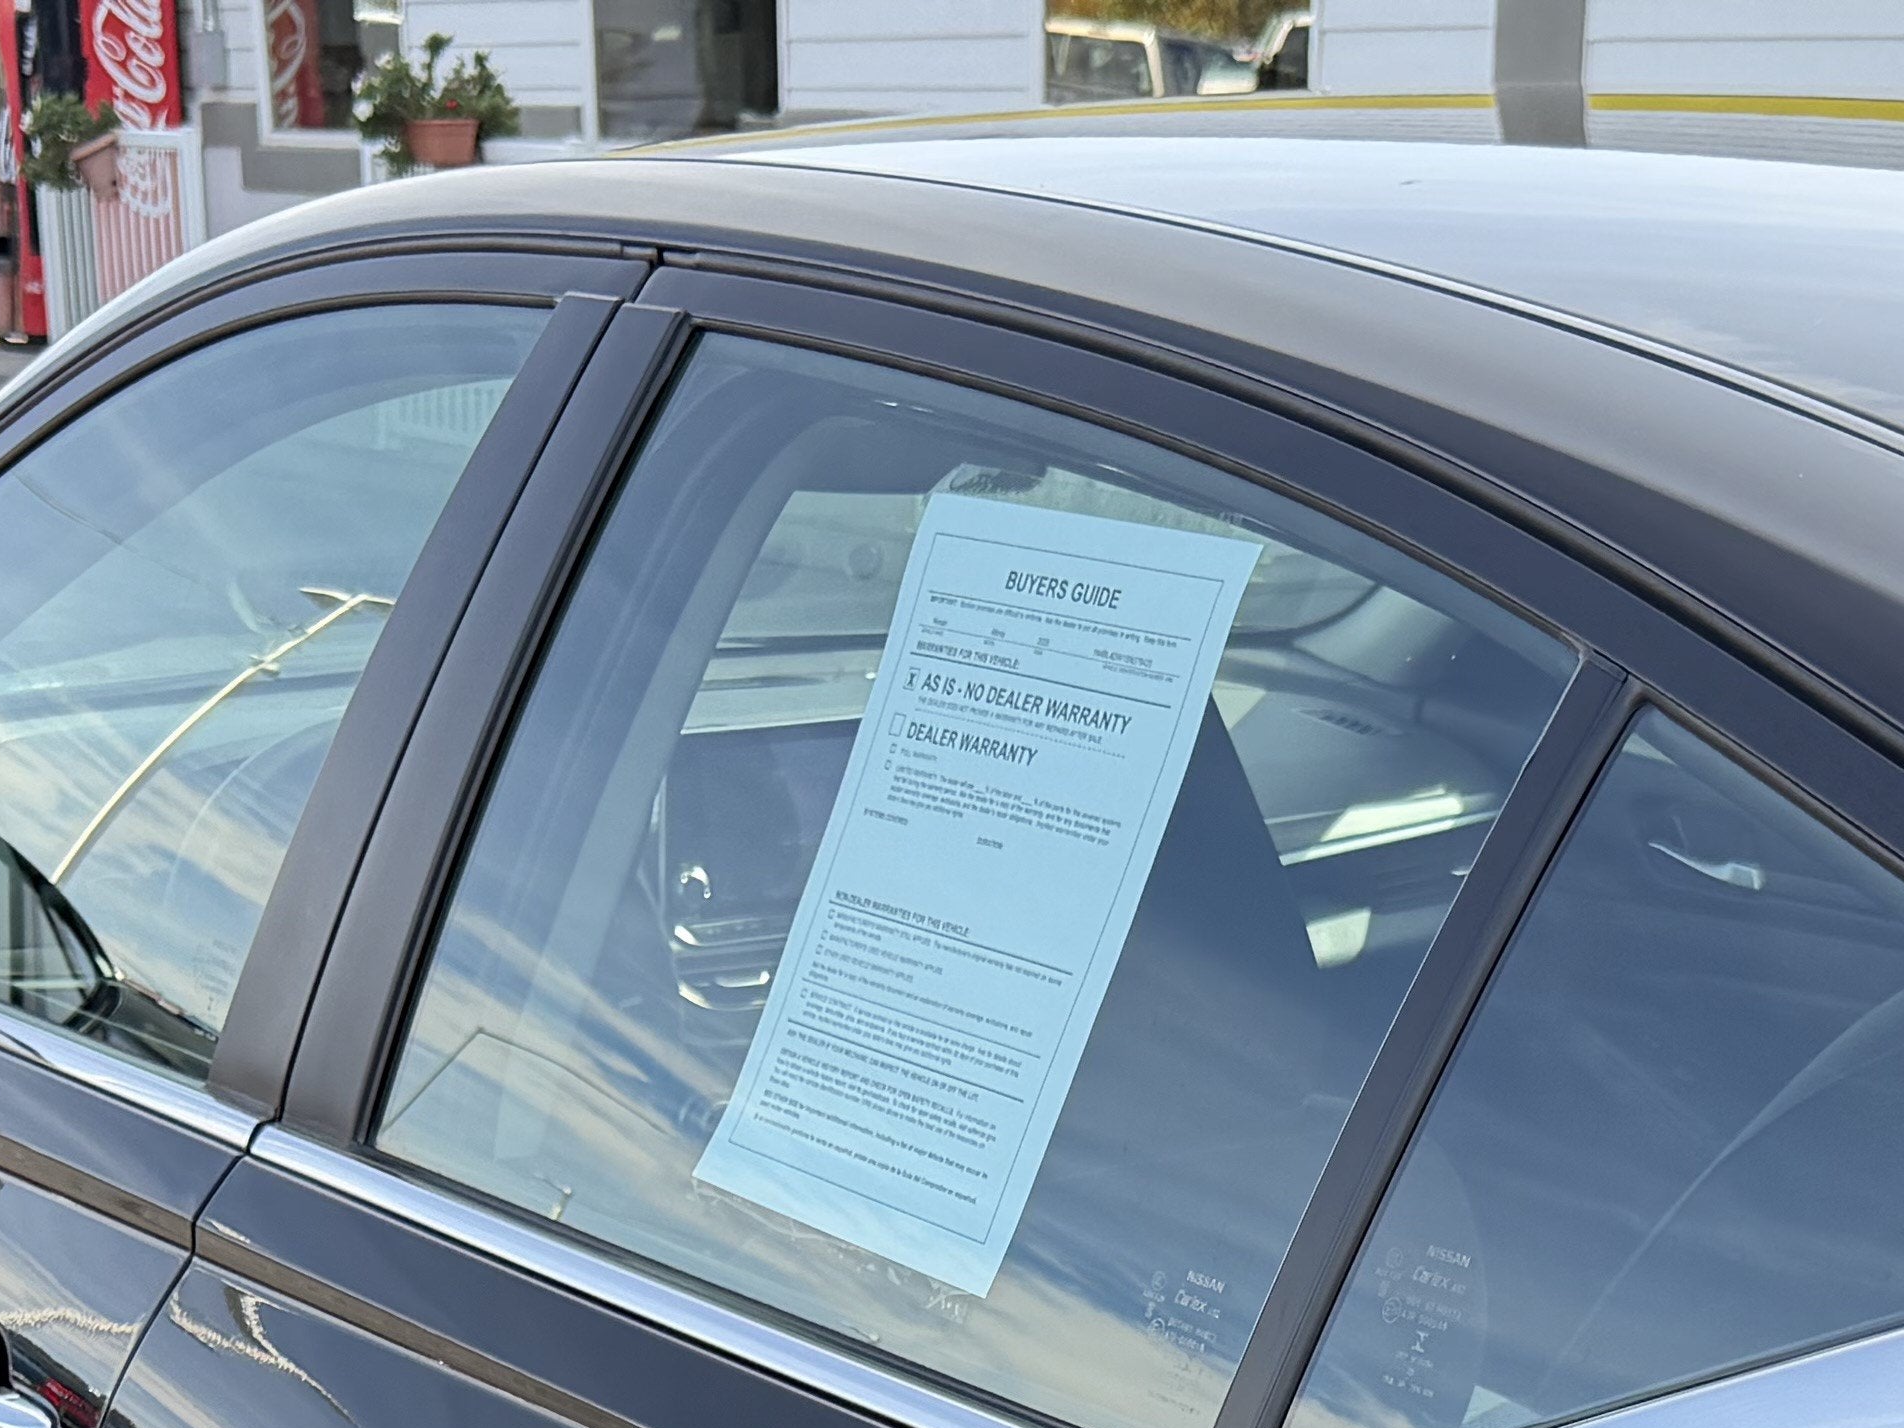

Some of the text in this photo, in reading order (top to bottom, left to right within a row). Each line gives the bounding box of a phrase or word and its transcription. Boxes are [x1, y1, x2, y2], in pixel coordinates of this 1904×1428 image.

[1004, 570, 1122, 610] BUYERS GUIDE
[921, 673, 940, 692] AS
[942, 677, 955, 695] IS
[964, 681, 985, 701] NO
[986, 686, 1043, 715] DEALER
[1046, 698, 1132, 735] WARRANTY
[907, 721, 957, 749] DEALER
[959, 733, 1038, 767] WARRANTY
[1426, 1245, 1472, 1268] NISSAN
[1186, 1270, 1225, 1294] NISSAN
